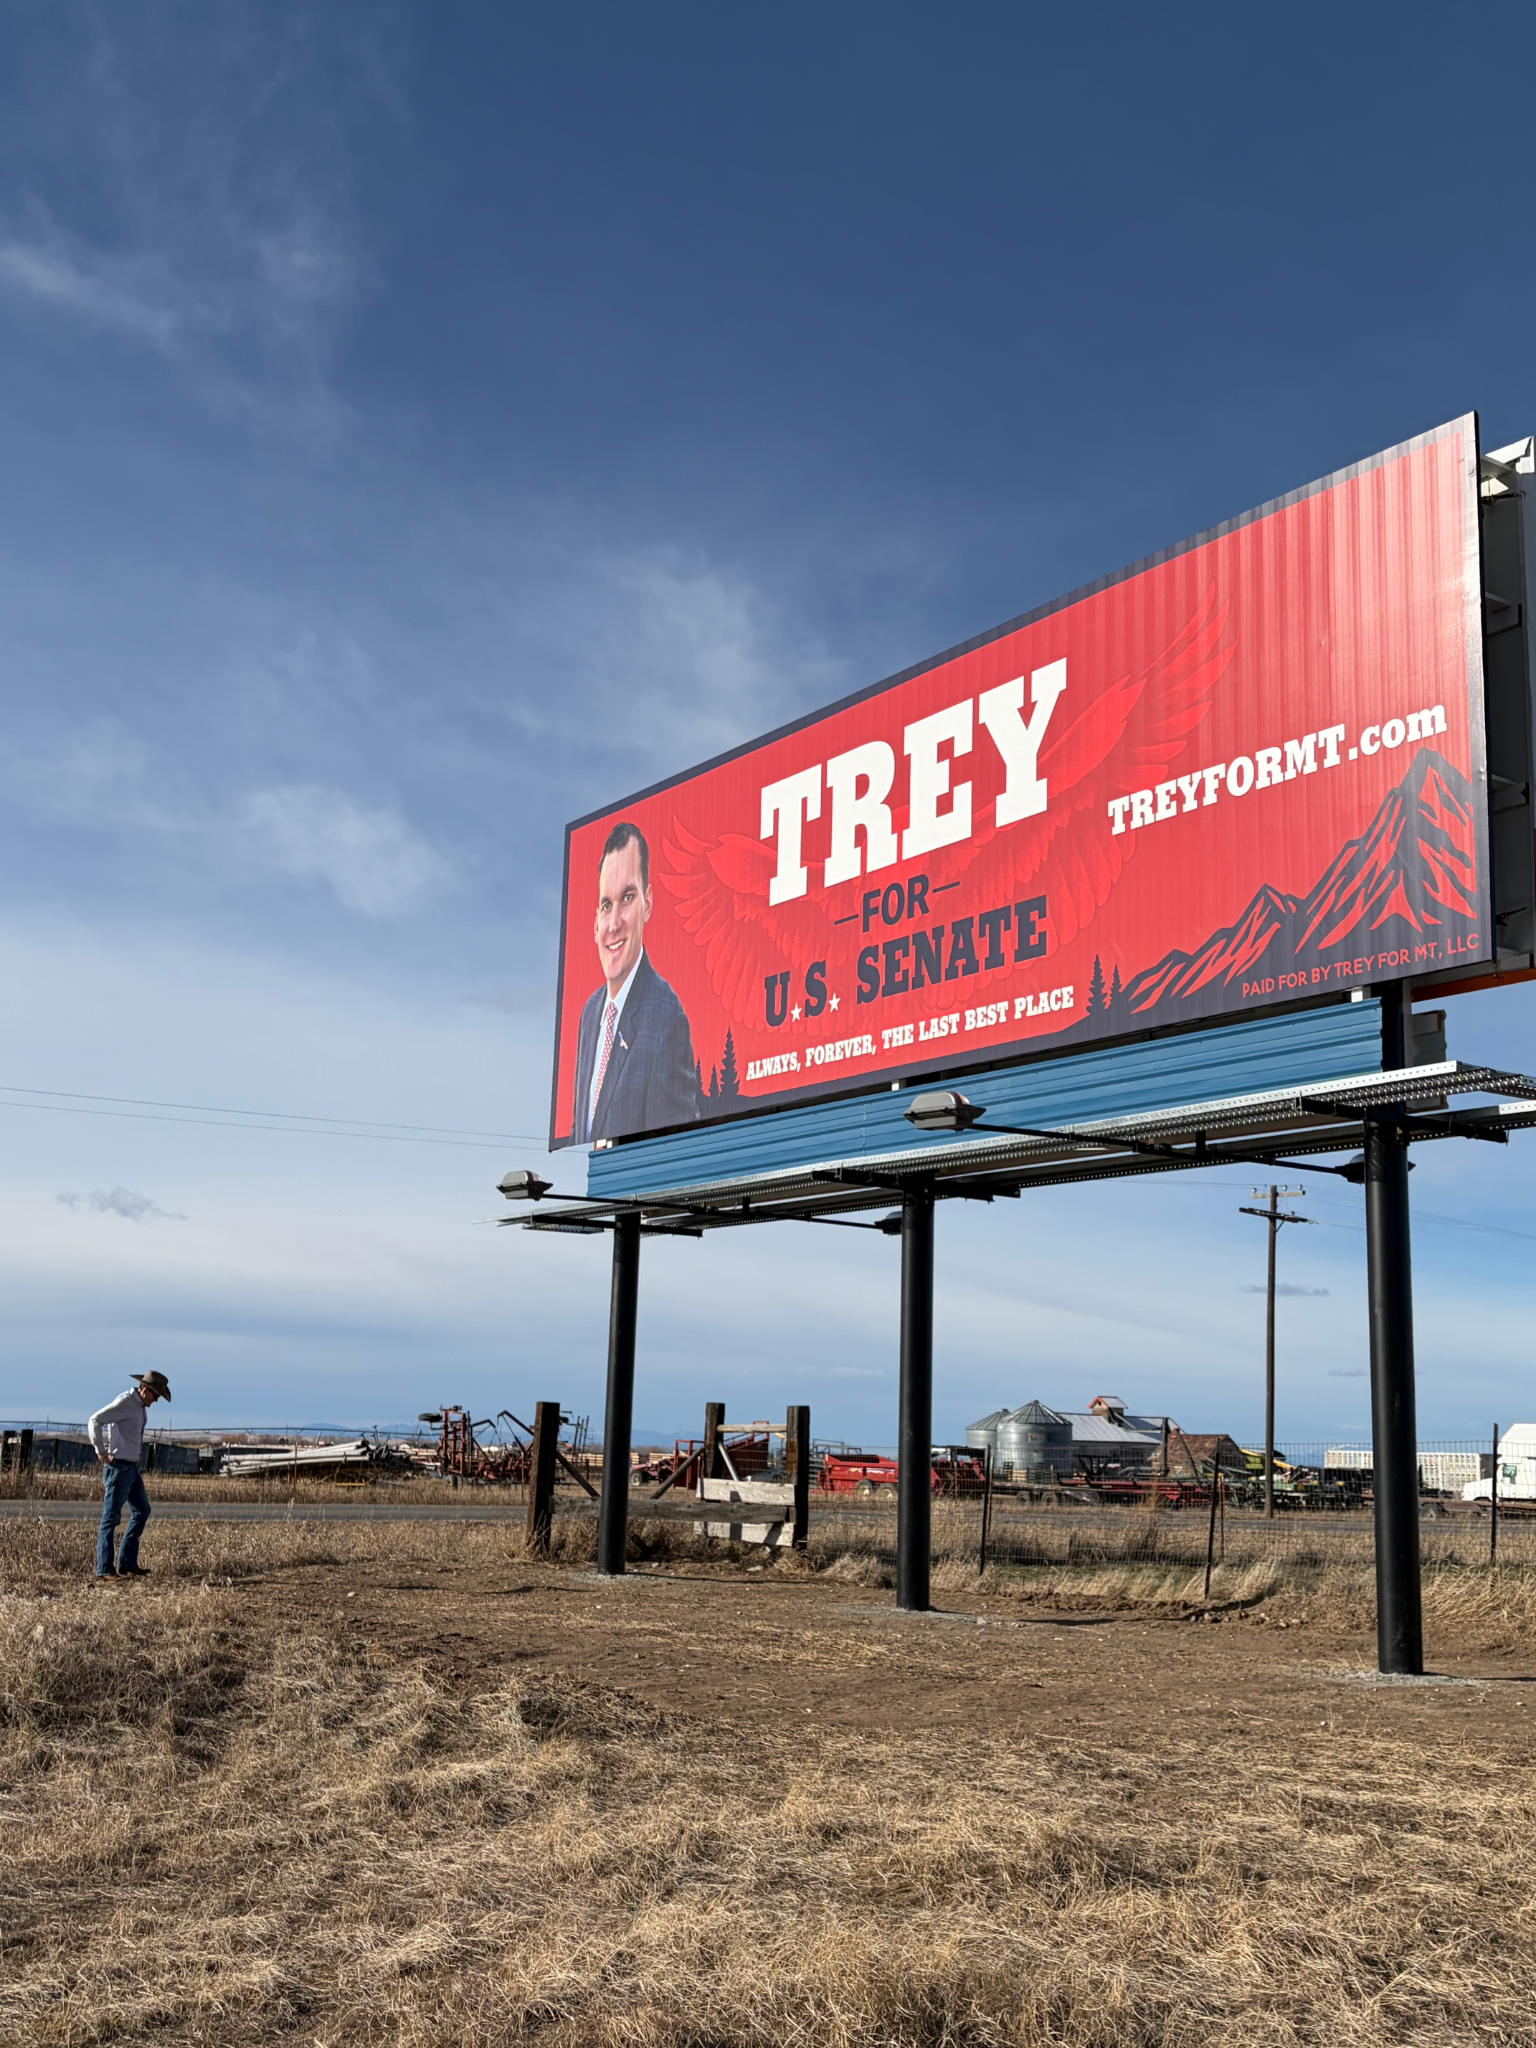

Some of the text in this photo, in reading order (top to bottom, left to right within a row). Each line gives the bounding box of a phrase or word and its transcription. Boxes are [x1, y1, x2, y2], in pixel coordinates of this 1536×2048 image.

[760, 657, 1067, 906] TREY
[1107, 704, 1447, 836] TREYFORMT.com
[855, 894, 1047, 1006] SENATE
[1242, 933, 1480, 998] PAID FOR BY TREY FOR MT, LLC
[746, 985, 1074, 1080] ALWAYS, FOREVER, THE LAST BEST PLACE
